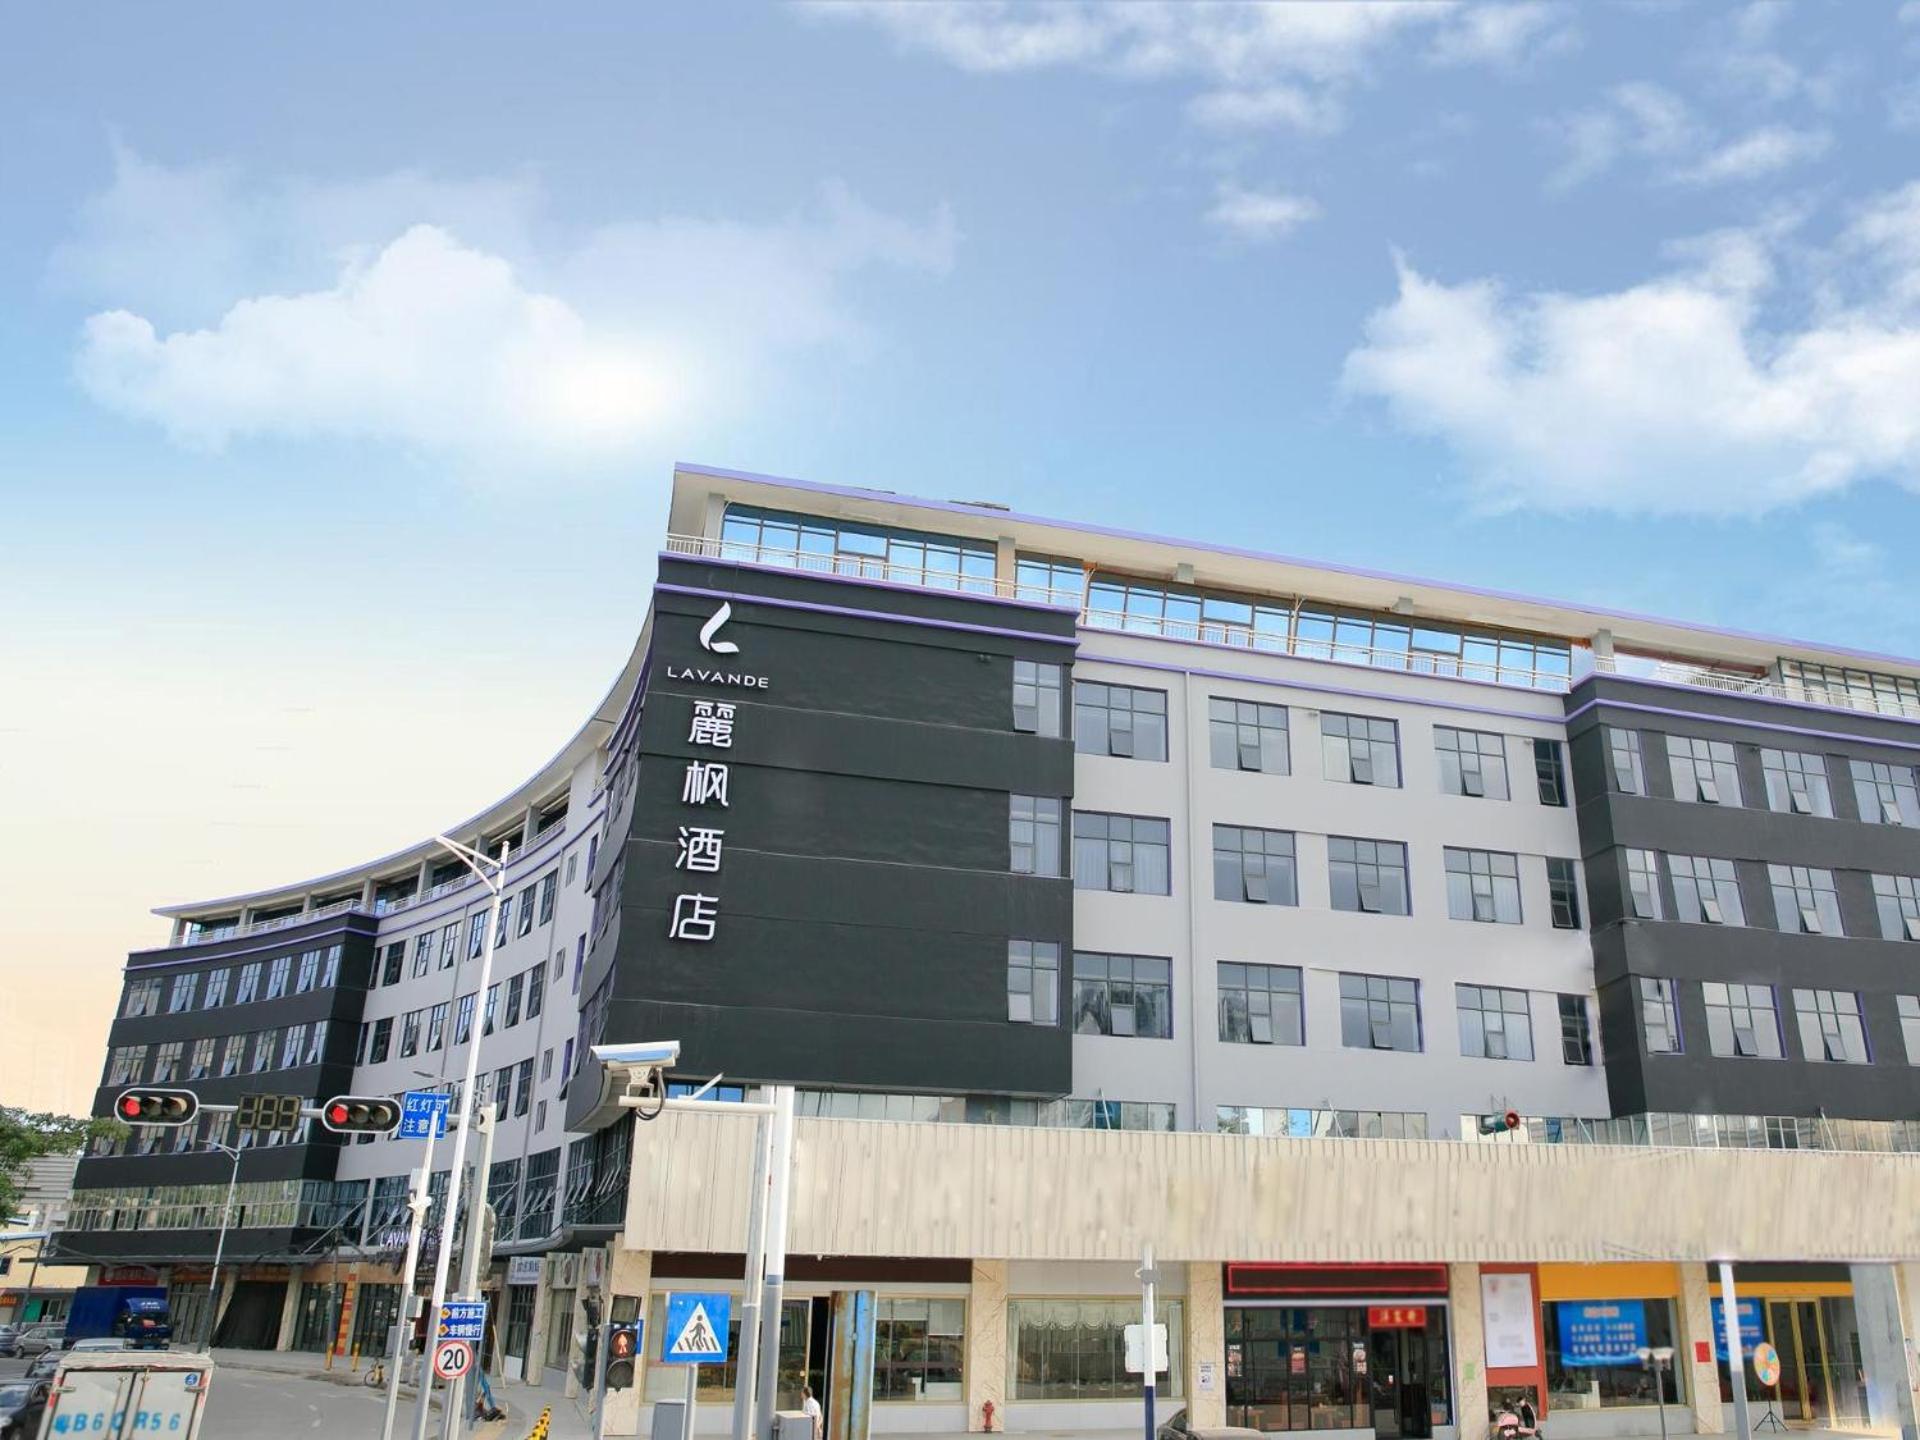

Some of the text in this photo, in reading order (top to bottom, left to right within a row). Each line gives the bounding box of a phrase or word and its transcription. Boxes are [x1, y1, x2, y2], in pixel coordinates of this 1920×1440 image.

[667, 666, 769, 689] LAVANDE
[669, 700, 737, 942] 麗枫酒店
[443, 1348, 465, 1370] 20
